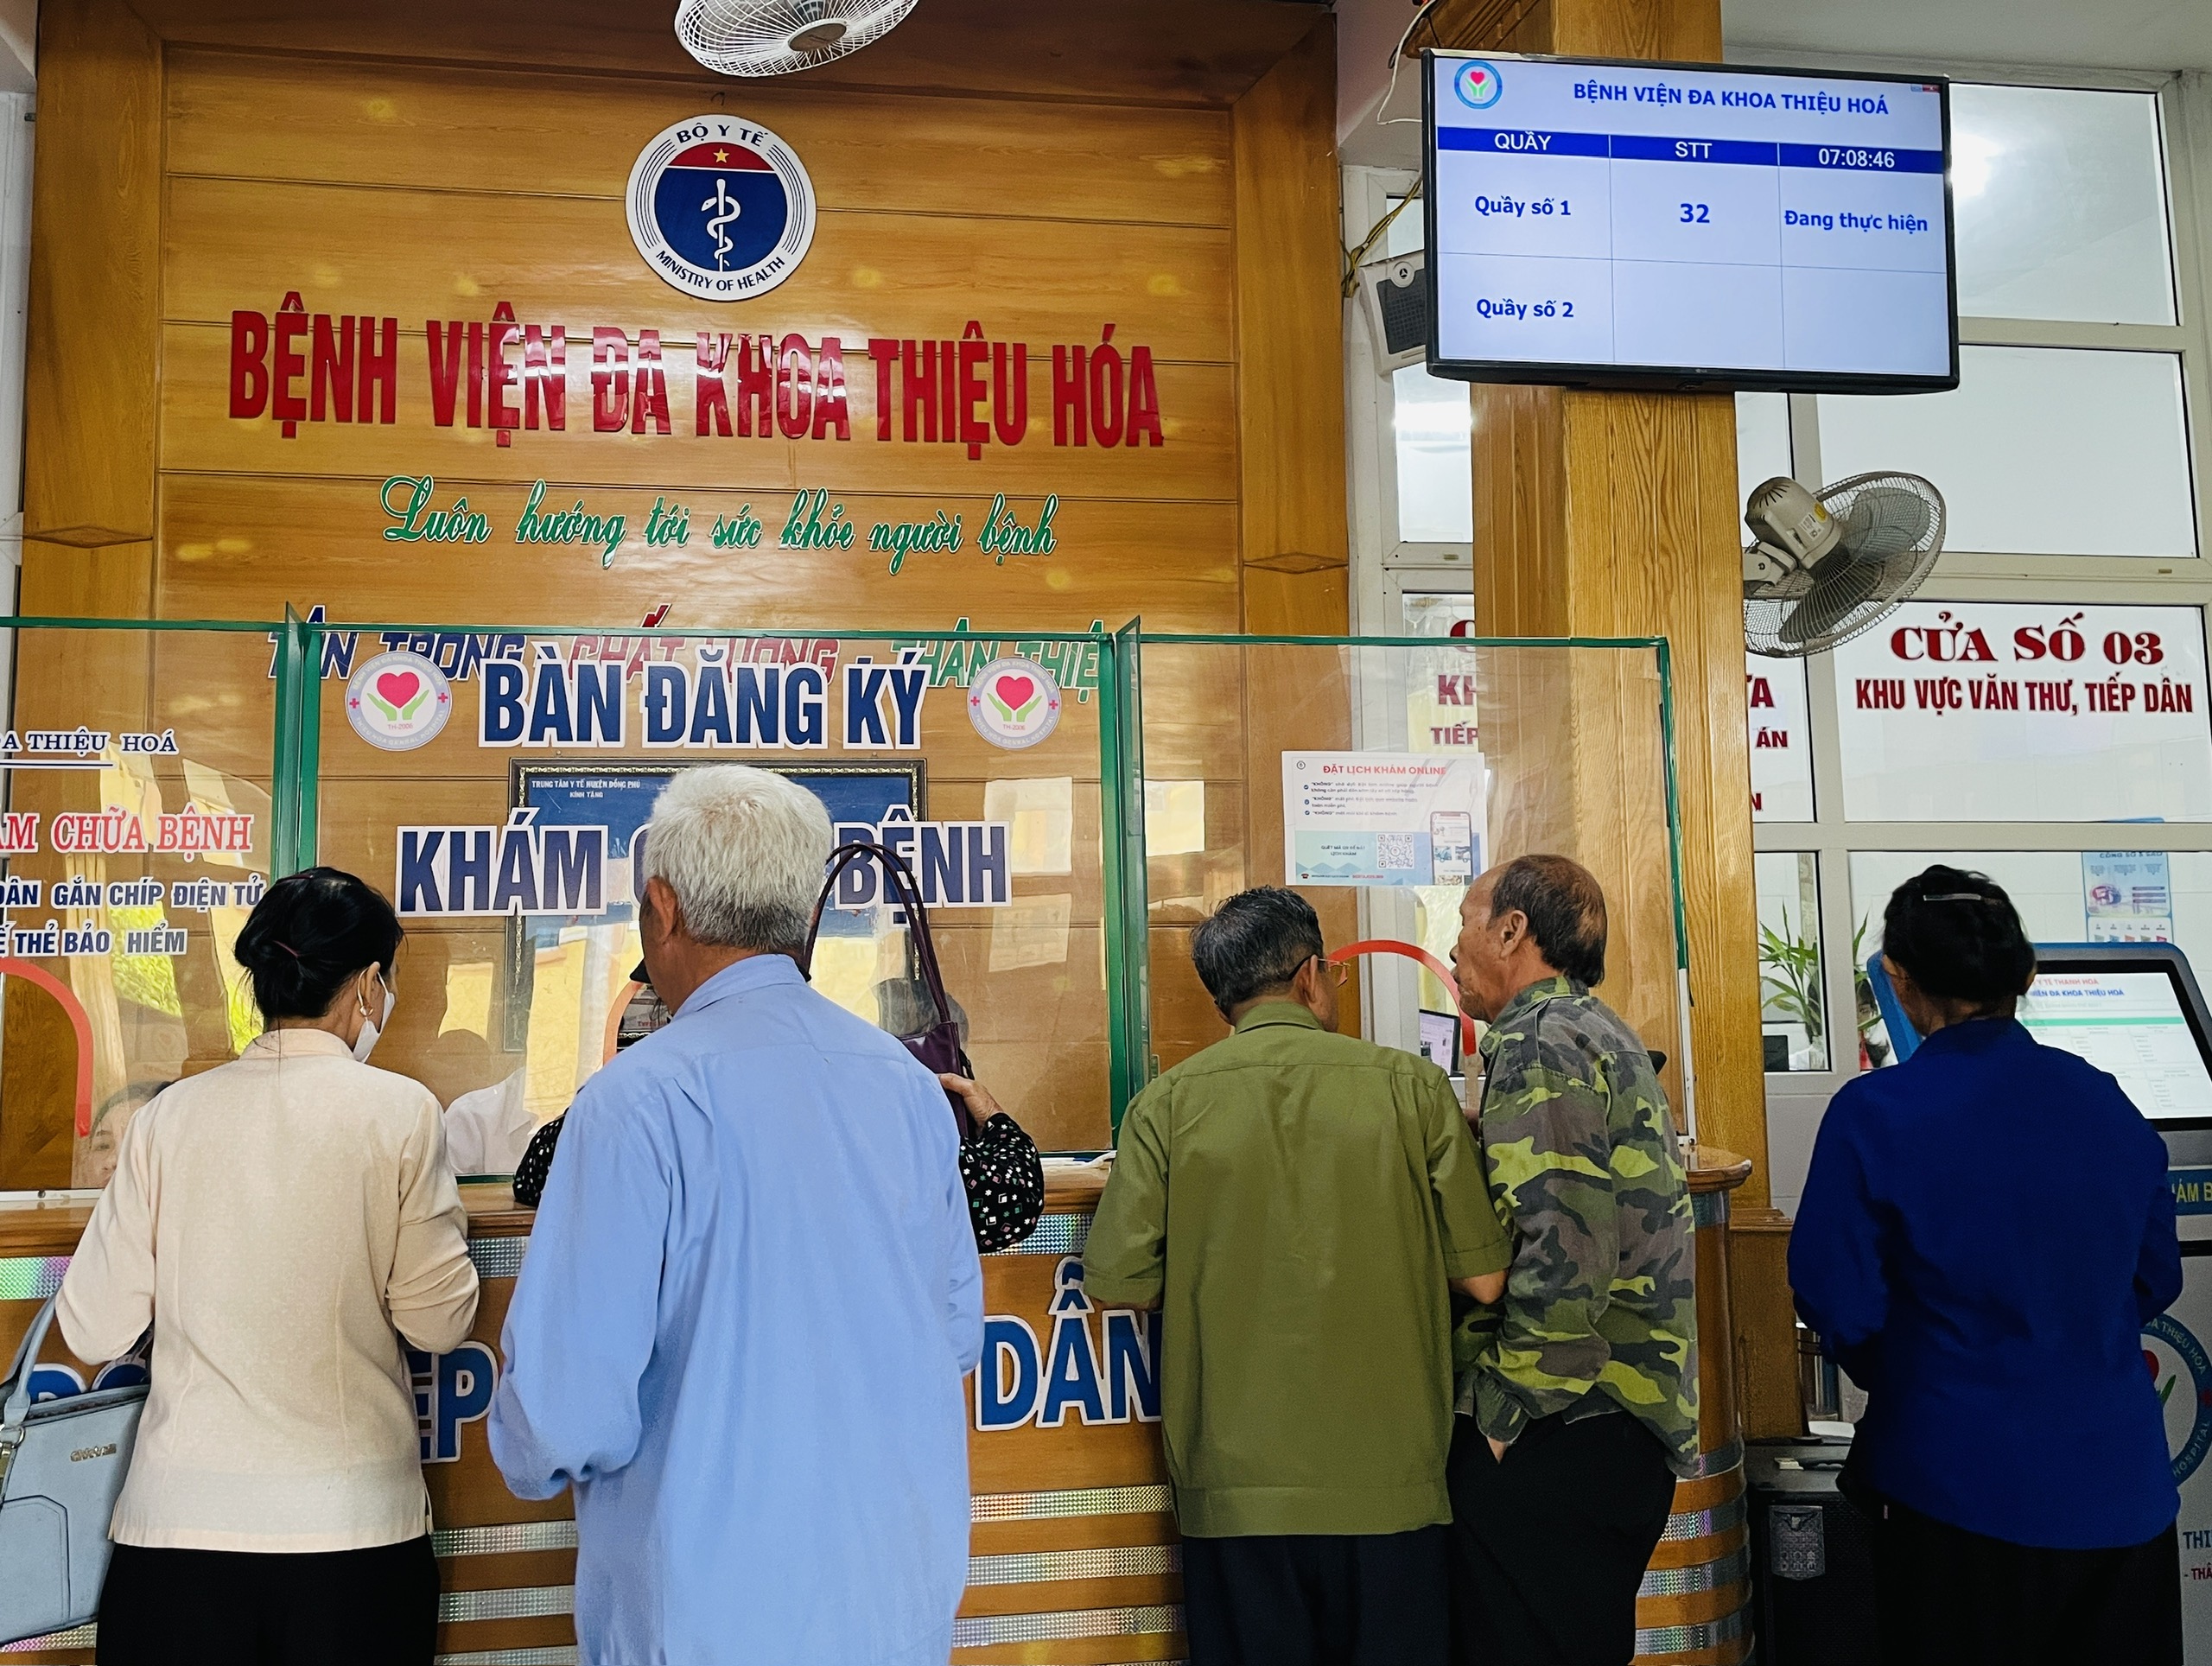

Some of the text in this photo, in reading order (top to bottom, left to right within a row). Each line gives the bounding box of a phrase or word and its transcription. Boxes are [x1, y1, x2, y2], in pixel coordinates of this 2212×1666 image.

[1573, 82, 1889, 114] BỆNH VIỆN ĐA KHOA THIỆU HOÁ
[676, 122, 769, 147] BỘ Y TẾ
[1494, 127, 1896, 169] QUẦY STT 07:08:46
[1474, 194, 1929, 233] Quầy số 1 32 Đang thực hiện
[656, 250, 785, 291] MINISTRY OF HEALTH
[1476, 297, 1574, 321] Quầy số 2
[229, 290, 1165, 461] BỆNH VIỆN ĐA KHOA THIỆU HÓA
[380, 474, 1058, 575] Luôn hướng tới sức khỏe người bệnh
[1891, 610, 2164, 665] CỬA SỐ 03
[1014, 620, 1100, 703] THIỆ
[480, 641, 626, 750] BÀN
[641, 645, 829, 750] ĐĂNG
[842, 648, 931, 750] KÝ
[1855, 671, 2194, 716] KHU VỰC VĂN THƯ, TIẾP DÂN
[28, 729, 108, 755] THIỆU
[122, 731, 178, 753] HOÁ
[1756, 726, 1789, 748] ÁN
[555, 779, 569, 788] TÂM
[576, 779, 585, 788] TẾ
[1323, 763, 1447, 777] ĐẶT LỊCH KHÁM ONLINE
[54, 806, 146, 851] CHỮA
[156, 805, 251, 861] BỆNH
[397, 807, 609, 917] KHÁM
[834, 804, 1012, 926] BỆNH
[54, 876, 102, 906] GẮN
[109, 878, 164, 906] CHÍP
[173, 878, 226, 912] ĐIỆN
[234, 874, 265, 906] TỬ
[15, 922, 57, 954] THẺ
[65, 922, 111, 953] BẢO
[127, 921, 187, 953] HIỂM
